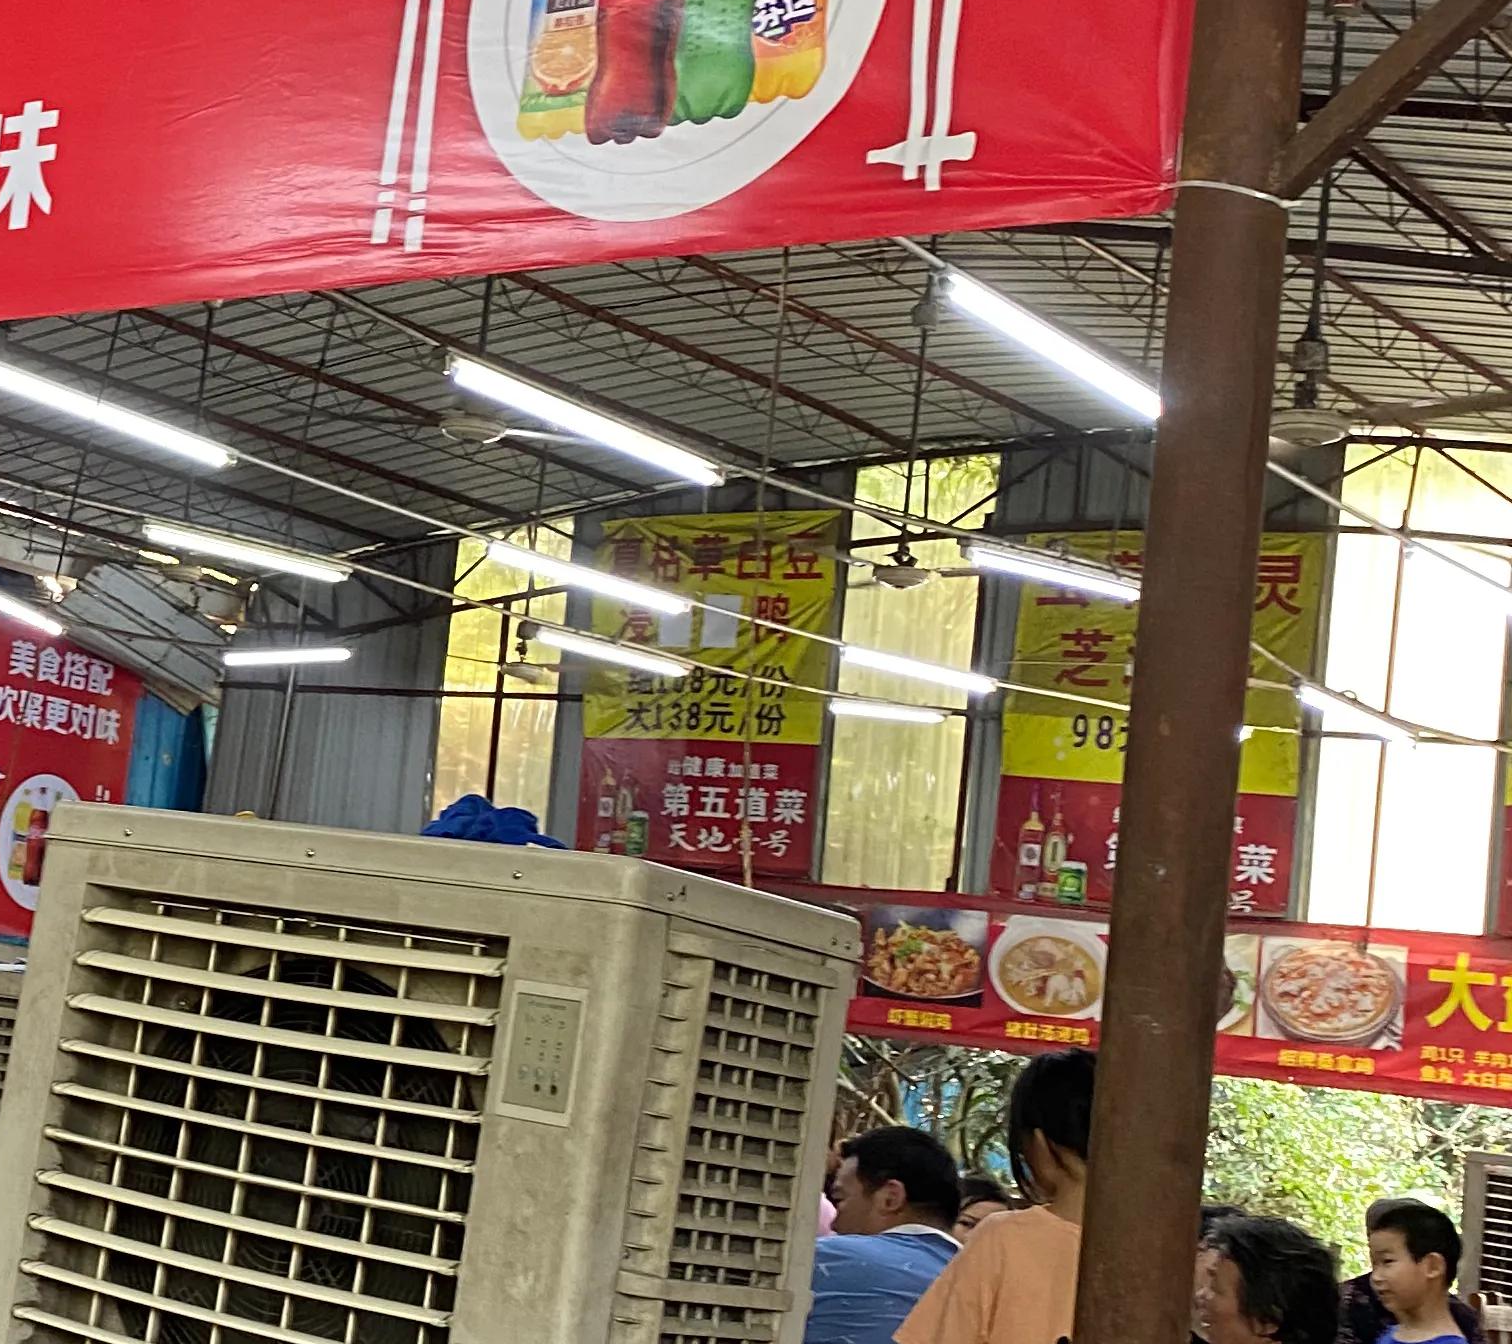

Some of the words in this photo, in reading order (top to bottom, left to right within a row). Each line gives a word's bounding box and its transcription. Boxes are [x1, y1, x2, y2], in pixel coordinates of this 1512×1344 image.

[9, 640, 115, 696] 美食搭配
[1072, 713, 1128, 752] 98
[660, 783, 808, 825] 第五道菜
